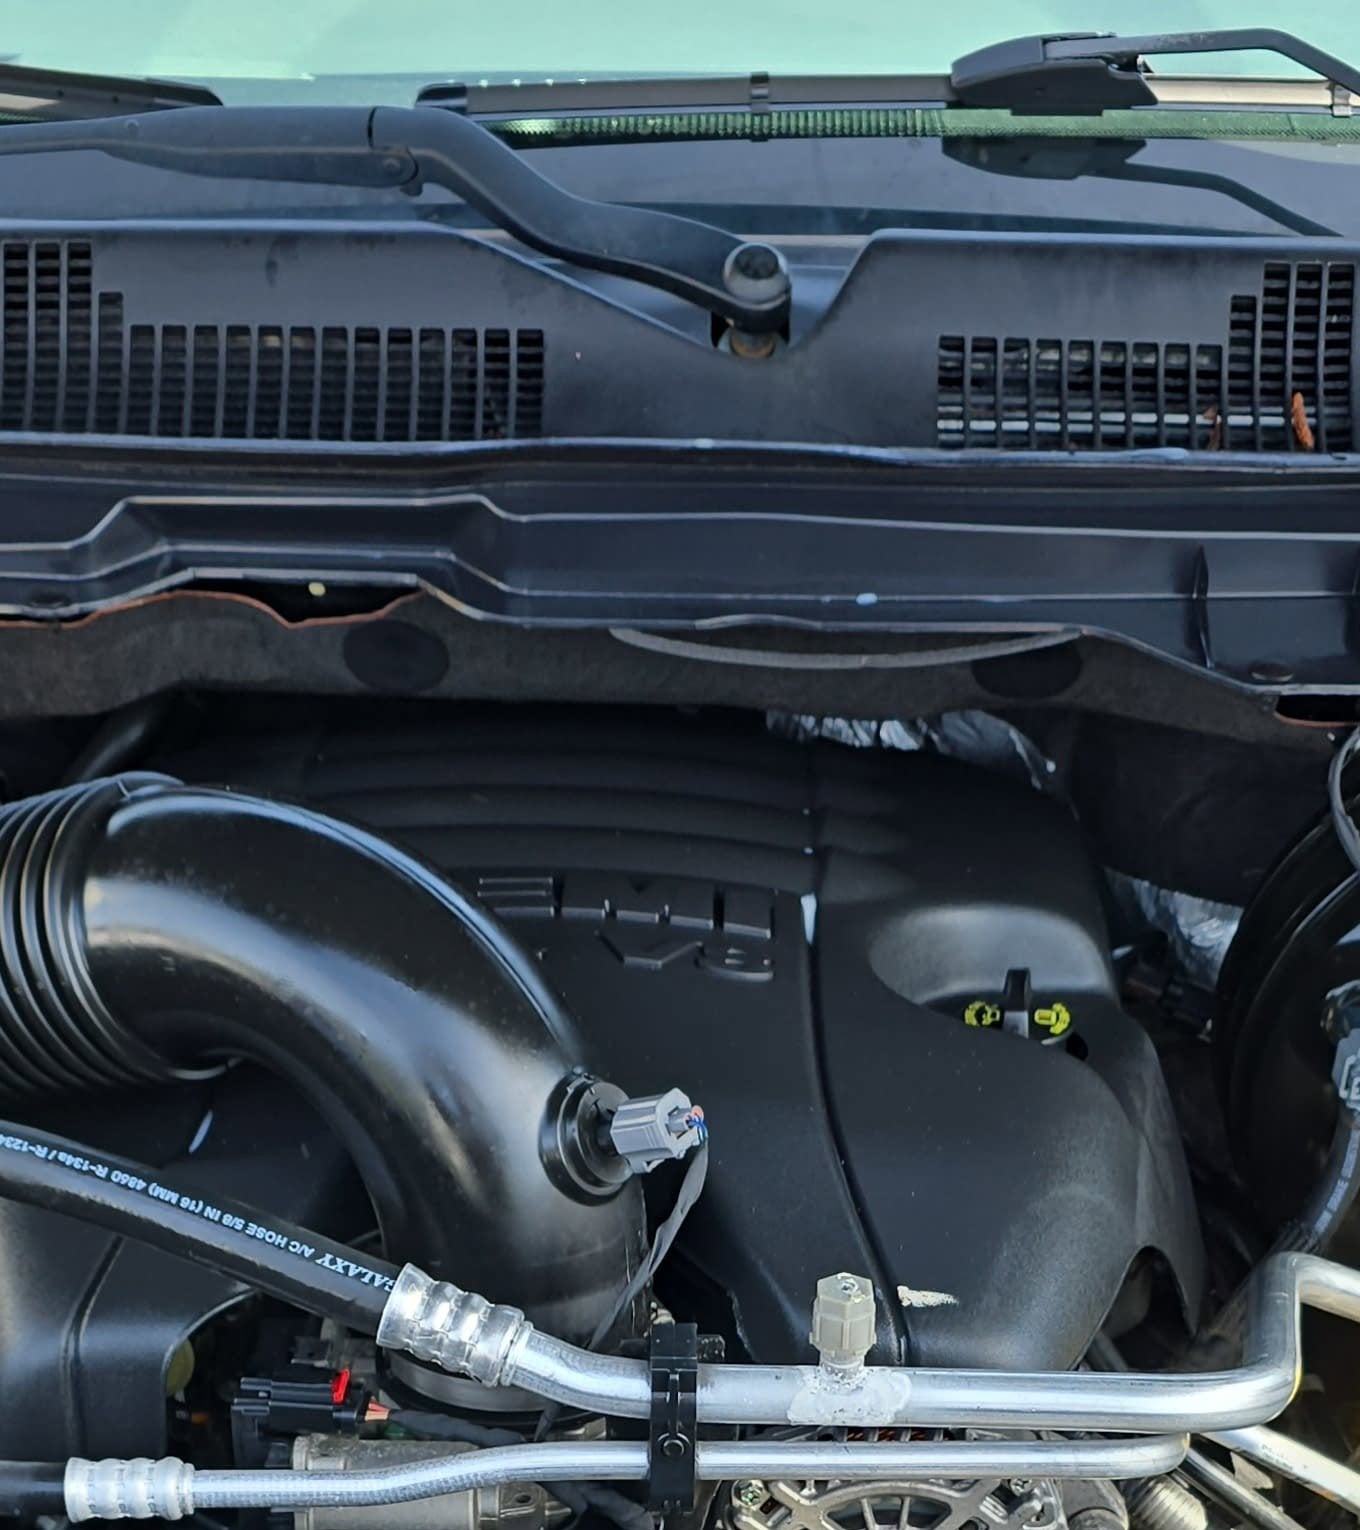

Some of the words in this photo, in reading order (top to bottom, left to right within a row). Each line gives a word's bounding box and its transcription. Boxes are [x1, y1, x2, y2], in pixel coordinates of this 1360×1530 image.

[57, 1151, 109, 1179] R-134a
[110, 1169, 147, 1191] 4860
[148, 1182, 181, 1206] MM)
[180, 1195, 204, 1214] (16
[203, 1204, 221, 1222] IN
[221, 1213, 246, 1232] 5/8
[245, 1222, 289, 1249] HOSE
[289, 1240, 315, 1258] A/C
